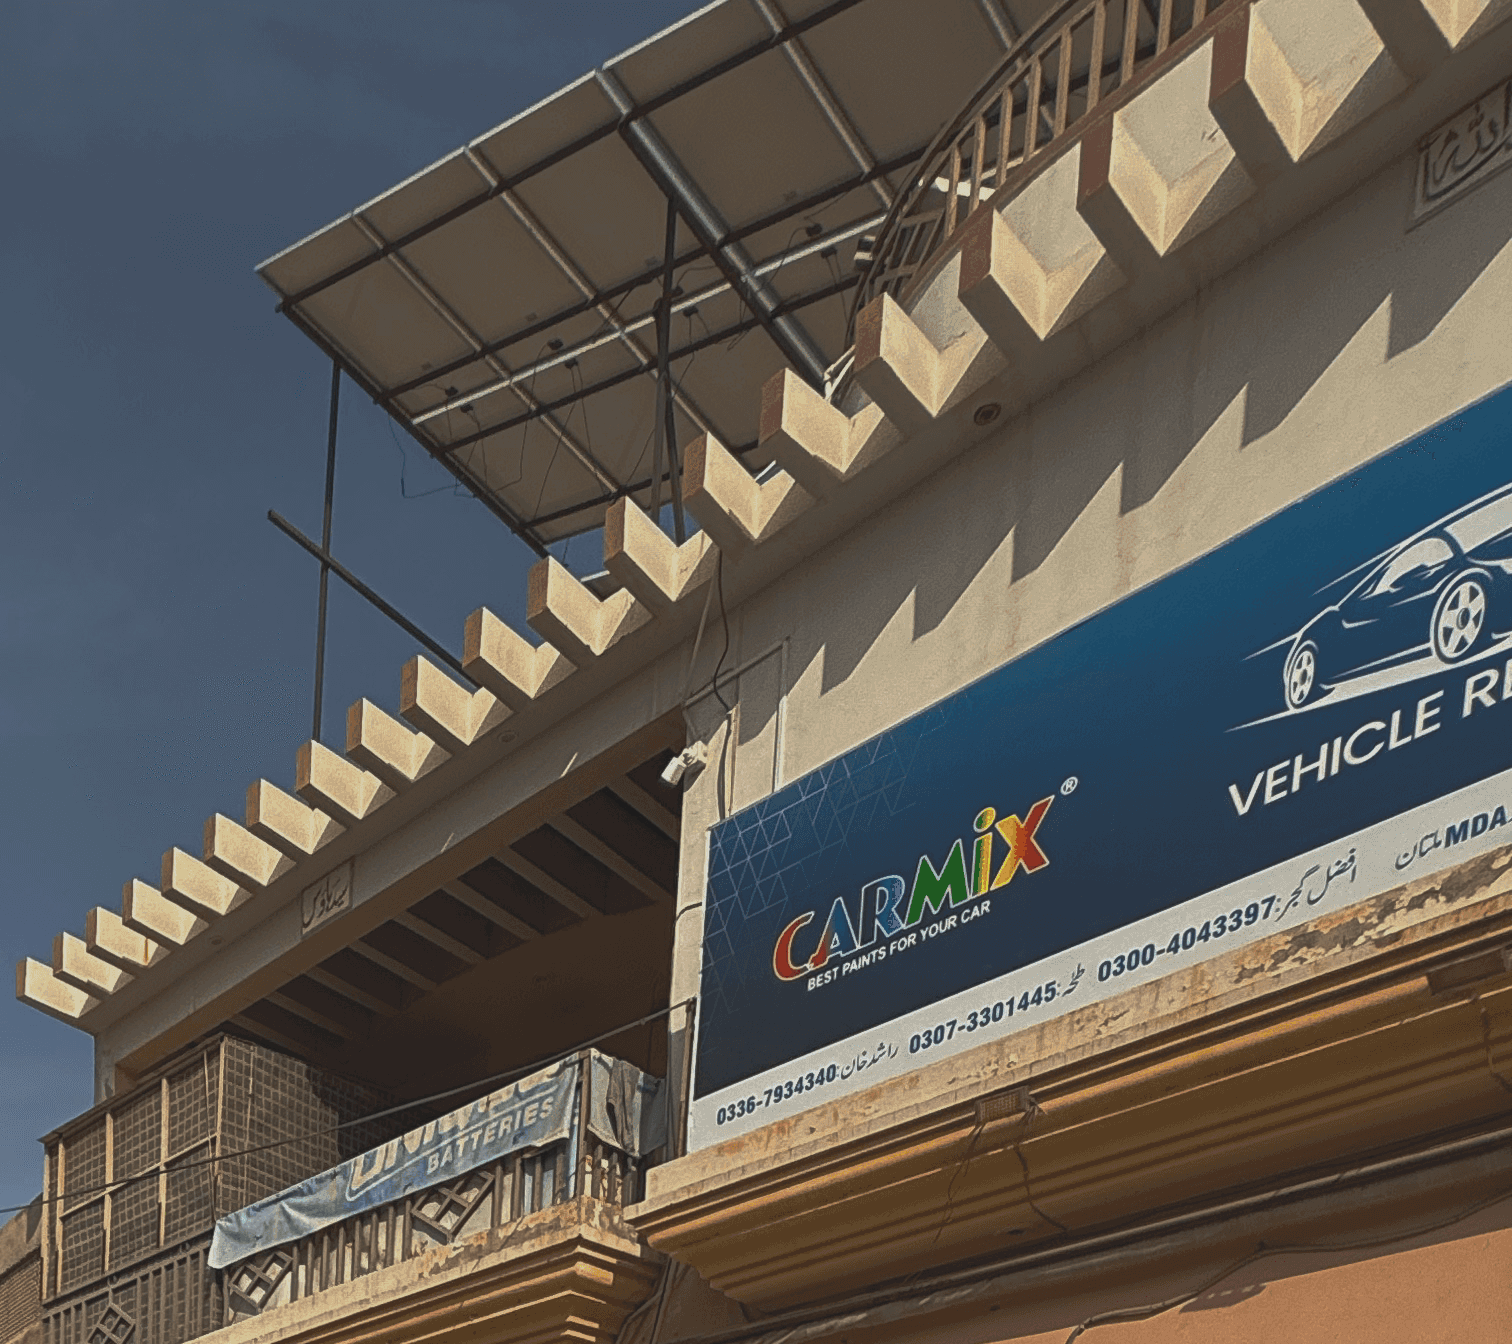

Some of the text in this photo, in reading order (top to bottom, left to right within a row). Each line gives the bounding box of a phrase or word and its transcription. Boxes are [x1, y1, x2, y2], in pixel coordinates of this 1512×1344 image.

[1228, 690, 1444, 816] VEHICLE
[807, 899, 991, 991] BEST PAINTS FOR YOUR CAR
[1097, 895, 1276, 982] 0300-4043397
[909, 980, 1056, 1054] 0307-3301445
[426, 1096, 554, 1175] BATTERIES
[716, 1063, 836, 1125] 0336-7934340
